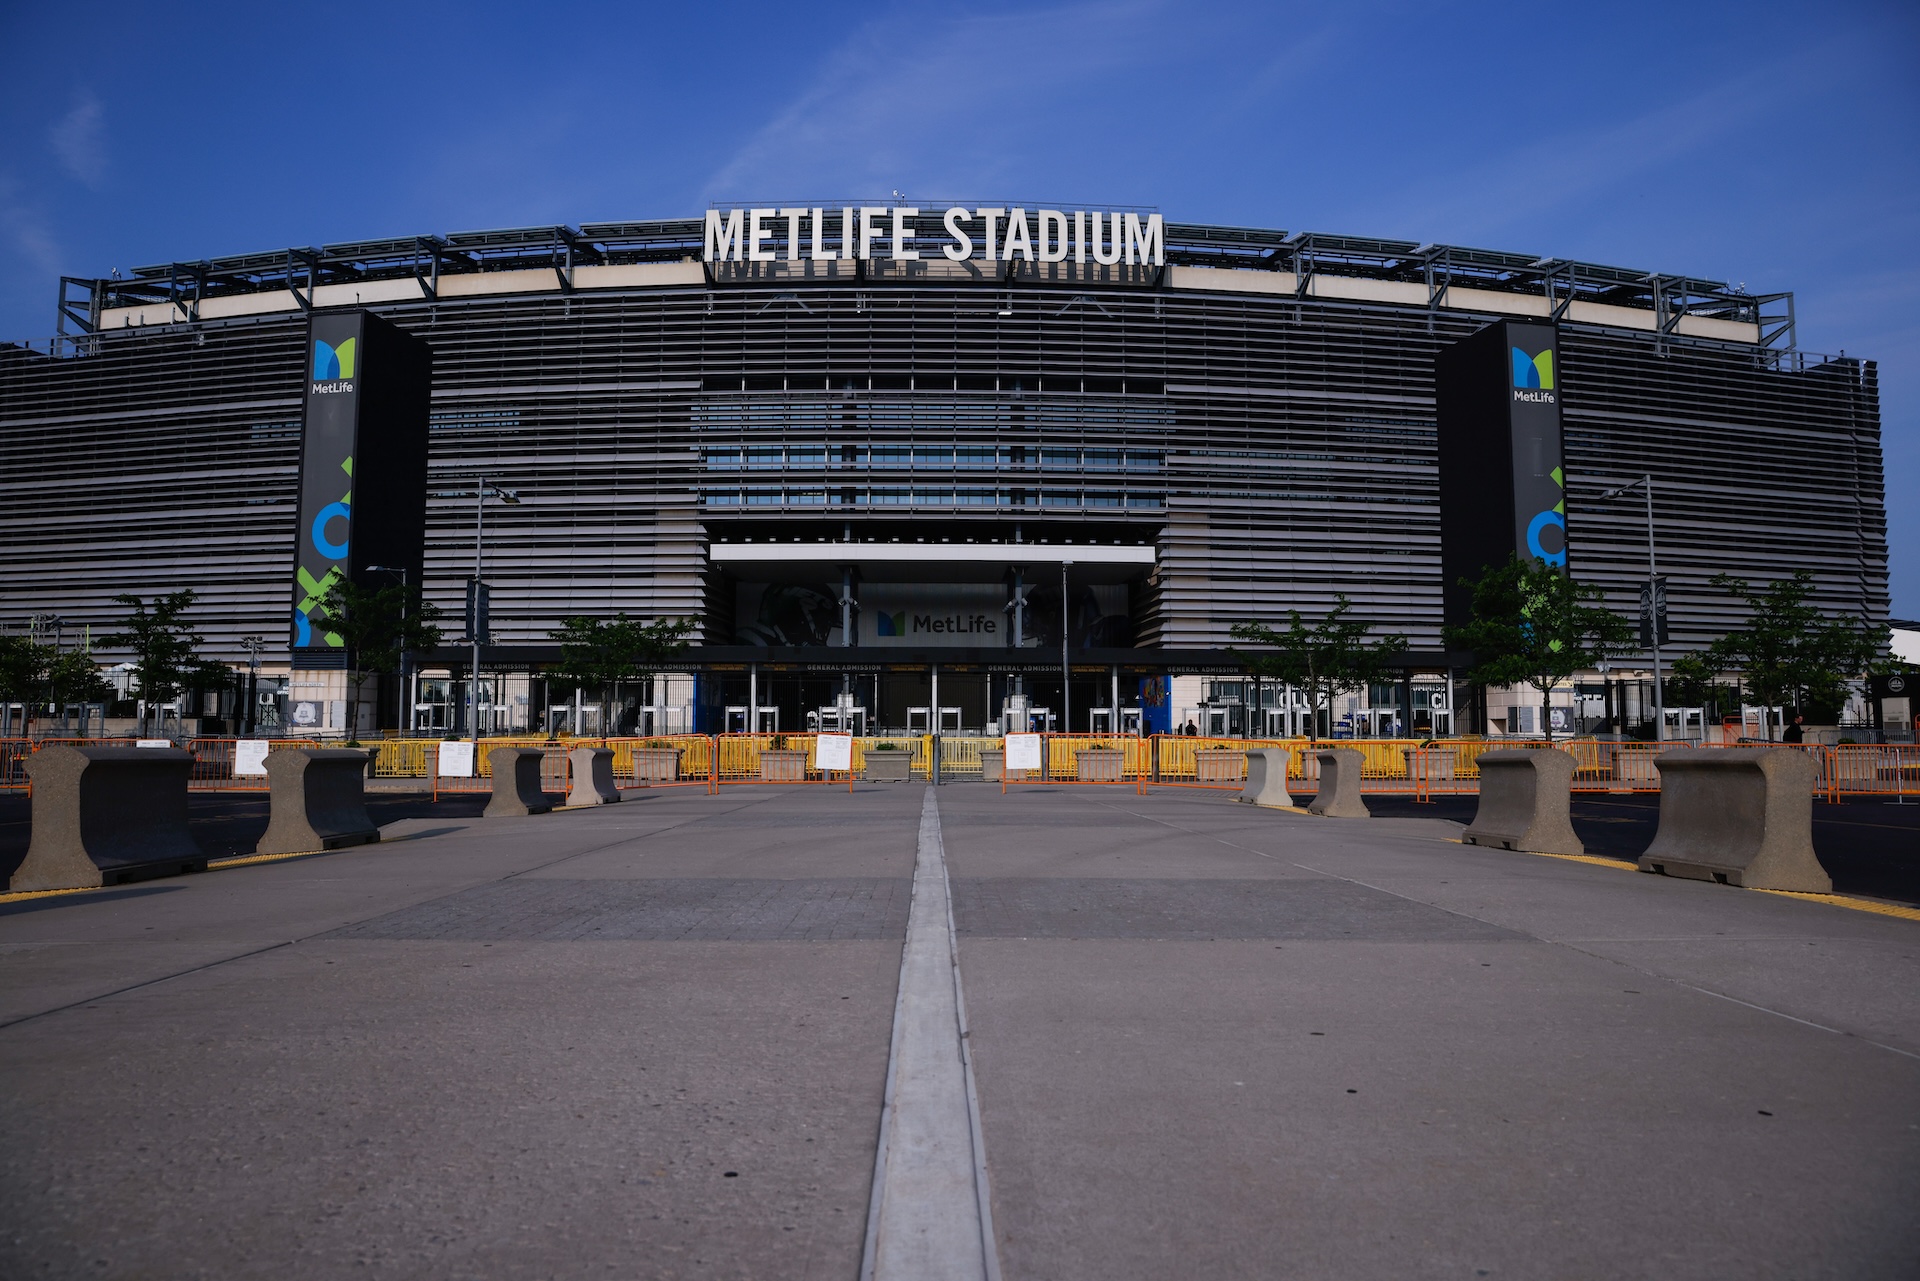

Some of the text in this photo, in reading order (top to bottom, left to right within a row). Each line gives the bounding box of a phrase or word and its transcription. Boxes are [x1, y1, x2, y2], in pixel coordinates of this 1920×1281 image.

[703, 207, 1165, 266] METLIFE STADIUM
[312, 381, 353, 394] MetLife
[1514, 390, 1555, 403] MetLife
[913, 615, 996, 633] MetLife
